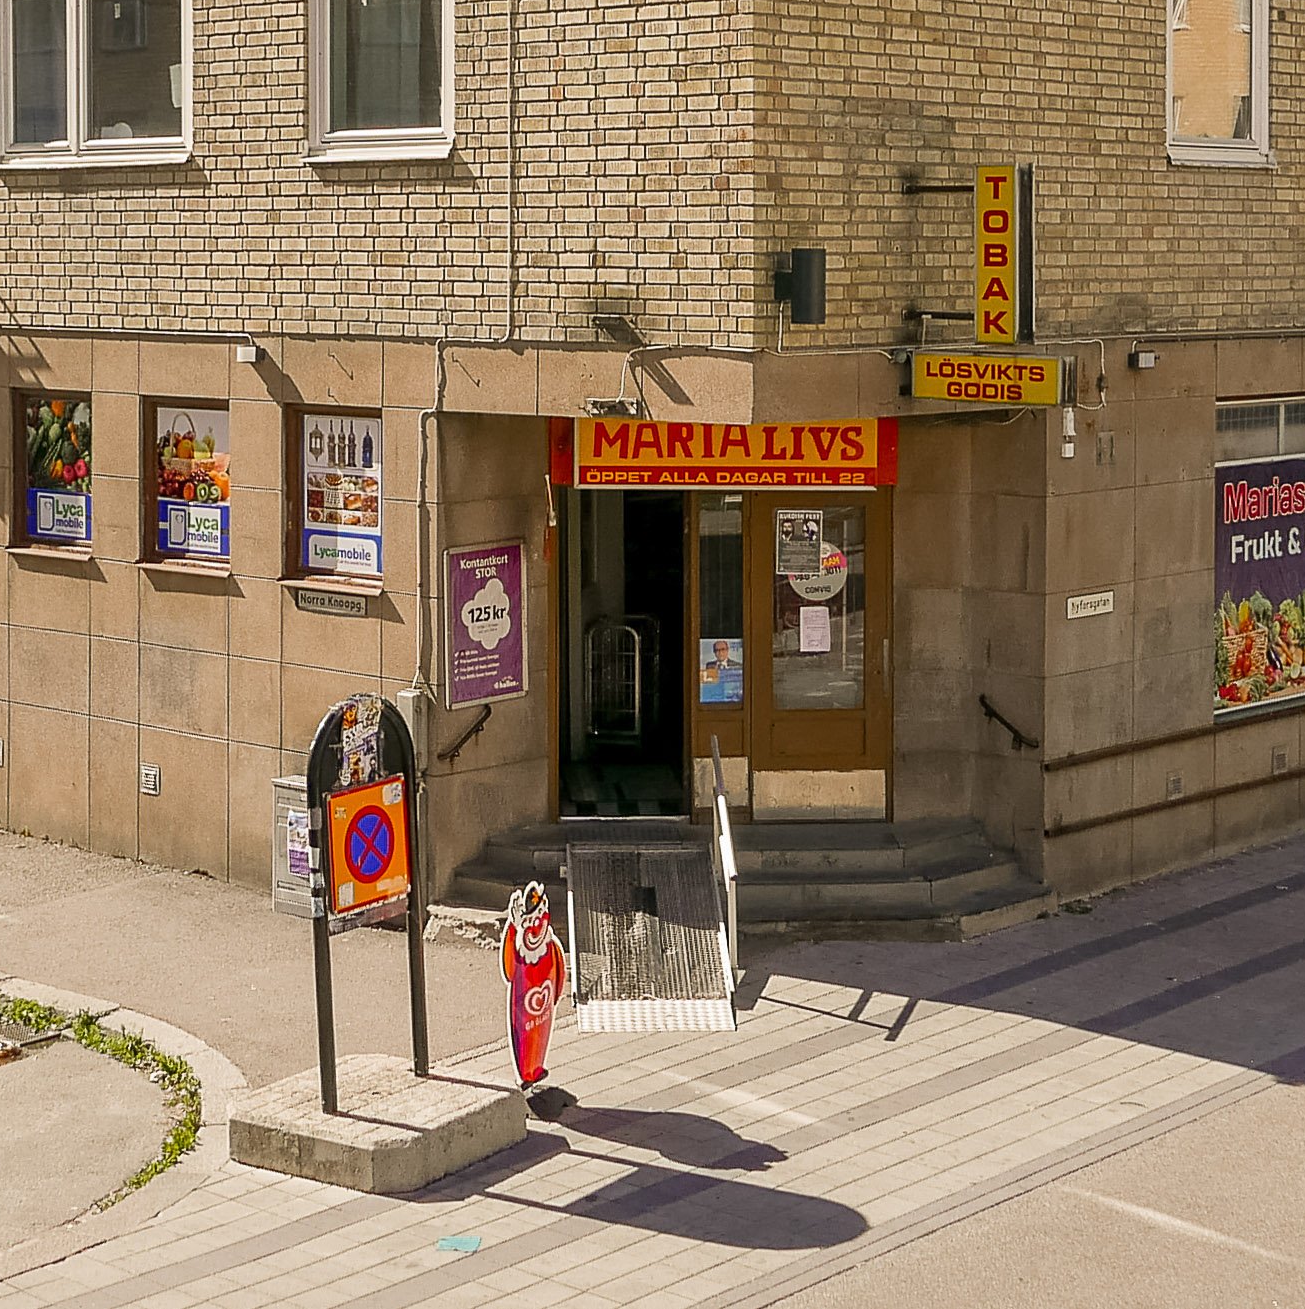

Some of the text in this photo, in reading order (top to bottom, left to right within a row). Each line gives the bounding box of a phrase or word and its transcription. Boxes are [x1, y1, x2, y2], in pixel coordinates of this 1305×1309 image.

[982, 176, 1009, 335] TOBAK
[926, 358, 1045, 382] LÖSVIKTS
[947, 381, 1023, 401] GODIS
[592, 422, 864, 461] MARIA LIVS
[586, 468, 865, 484] ÖPPET ALLA DAGAR TILL 22
[55, 499, 83, 518] Lyca
[55, 518, 83, 529] mobile
[188, 512, 219, 532] Lyca
[187, 531, 219, 543] mobile
[1231, 529, 1283, 563] Frukt
[1287, 527, 1301, 555] &
[314, 544, 372, 561] Lycamobile
[460, 554, 509, 569] Kontantkort
[475, 566, 497, 579] STOR
[300, 593, 326, 606] Norra
[468, 605, 507, 623] 125 kr
